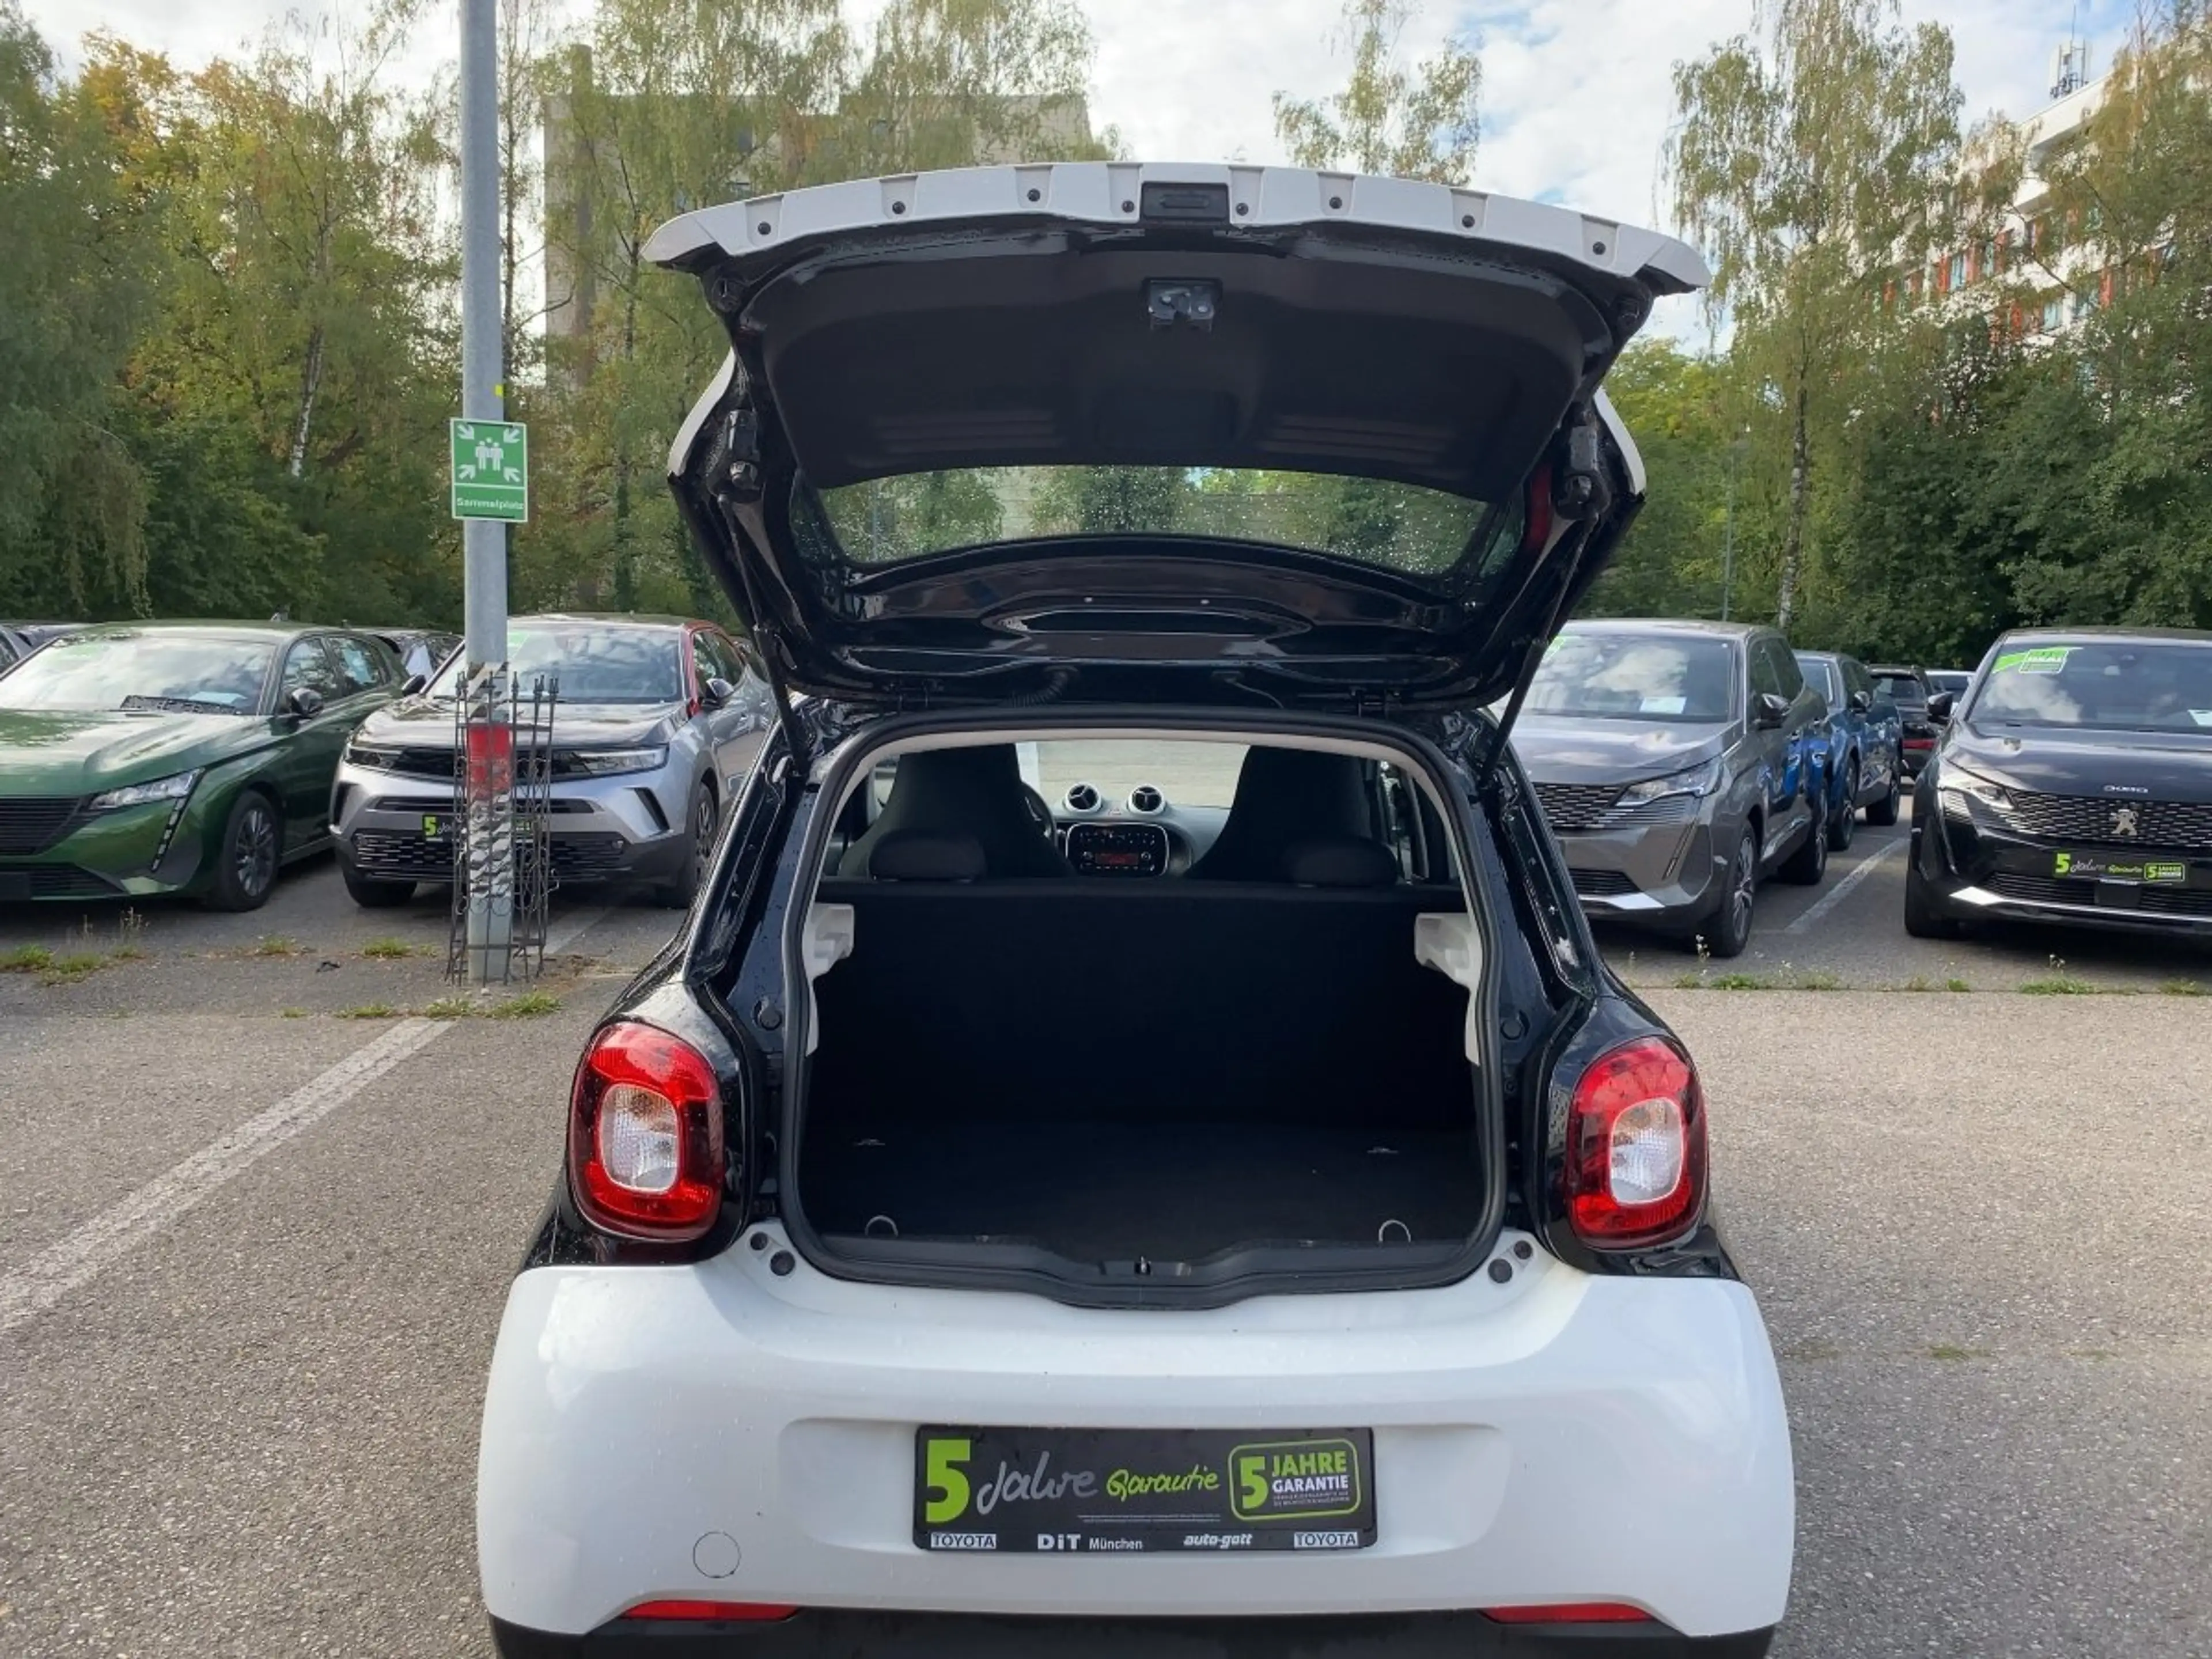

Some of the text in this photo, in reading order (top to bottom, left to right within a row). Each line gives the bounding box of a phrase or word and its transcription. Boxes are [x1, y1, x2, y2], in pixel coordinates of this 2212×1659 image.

[2055, 853, 2071, 873] 5
[1271, 1450, 1347, 1477] JAHRE
[926, 1440, 1221, 1522] 5 Jahre Garantie
[1240, 1456, 1269, 1509] 5
[1272, 1475, 1350, 1493] GARANTIE
[932, 1535, 997, 1548] TOYOTA
[1089, 1537, 1143, 1550] München
[1296, 1533, 1357, 1547] TOYOTA
